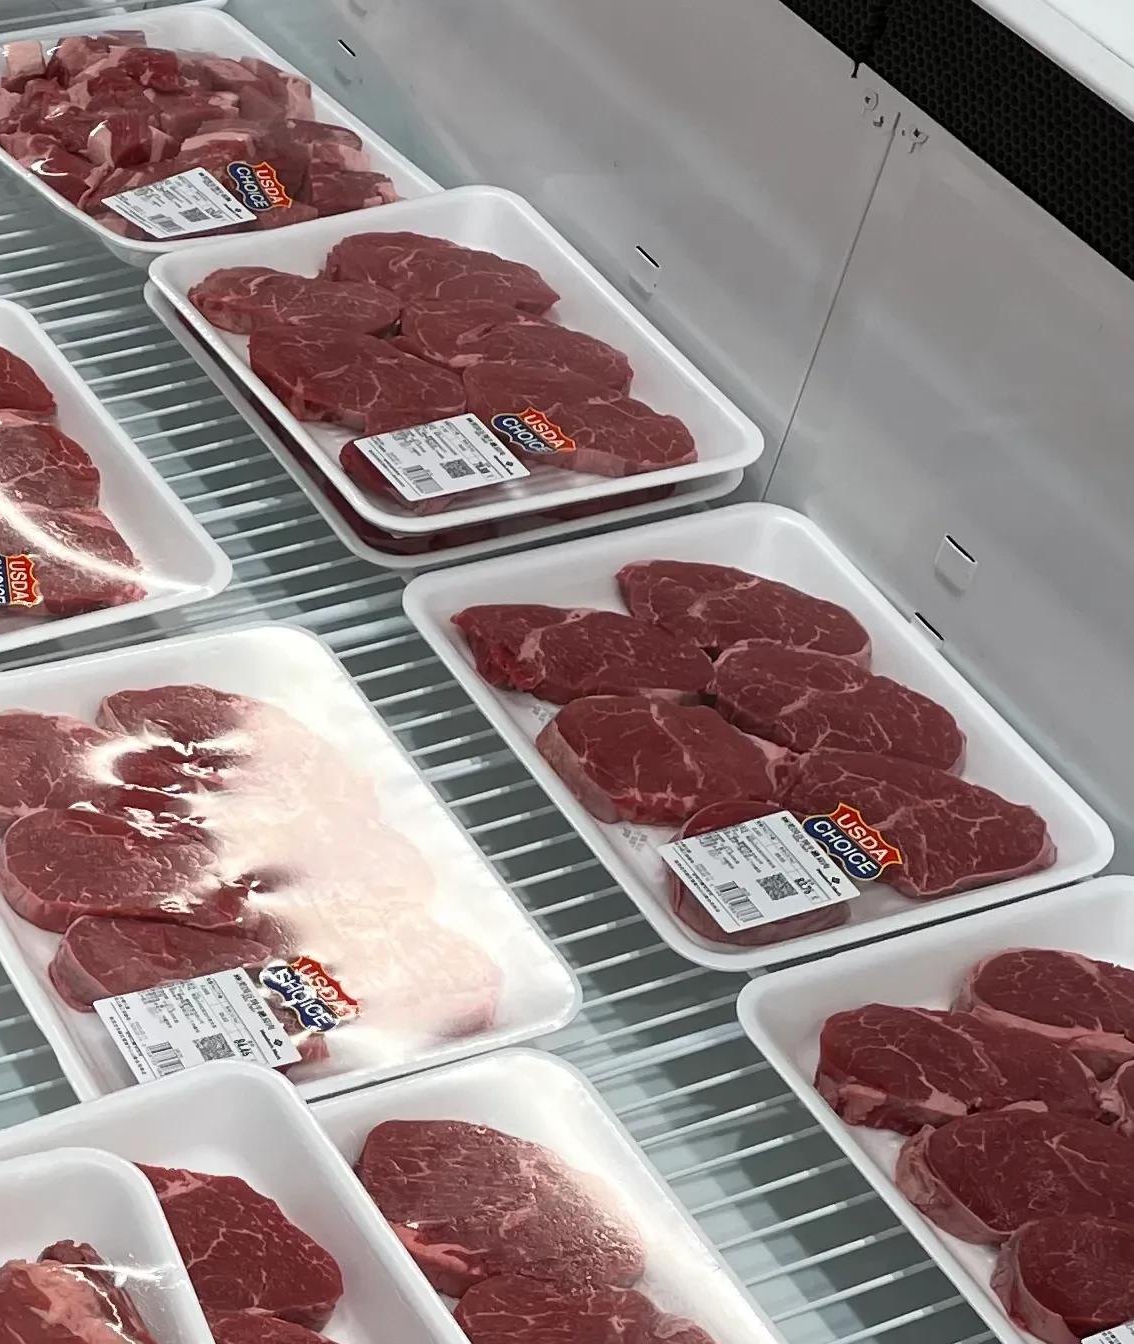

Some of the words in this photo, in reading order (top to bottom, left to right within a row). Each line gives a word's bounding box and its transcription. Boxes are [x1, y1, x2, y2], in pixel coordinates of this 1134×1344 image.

[236, 166, 269, 207] CHOICE
[256, 169, 285, 205] USDA
[524, 414, 565, 448] USDA
[9, 560, 29, 606] USDA
[813, 820, 878, 874] CHOICE
[836, 813, 889, 861] USDA
